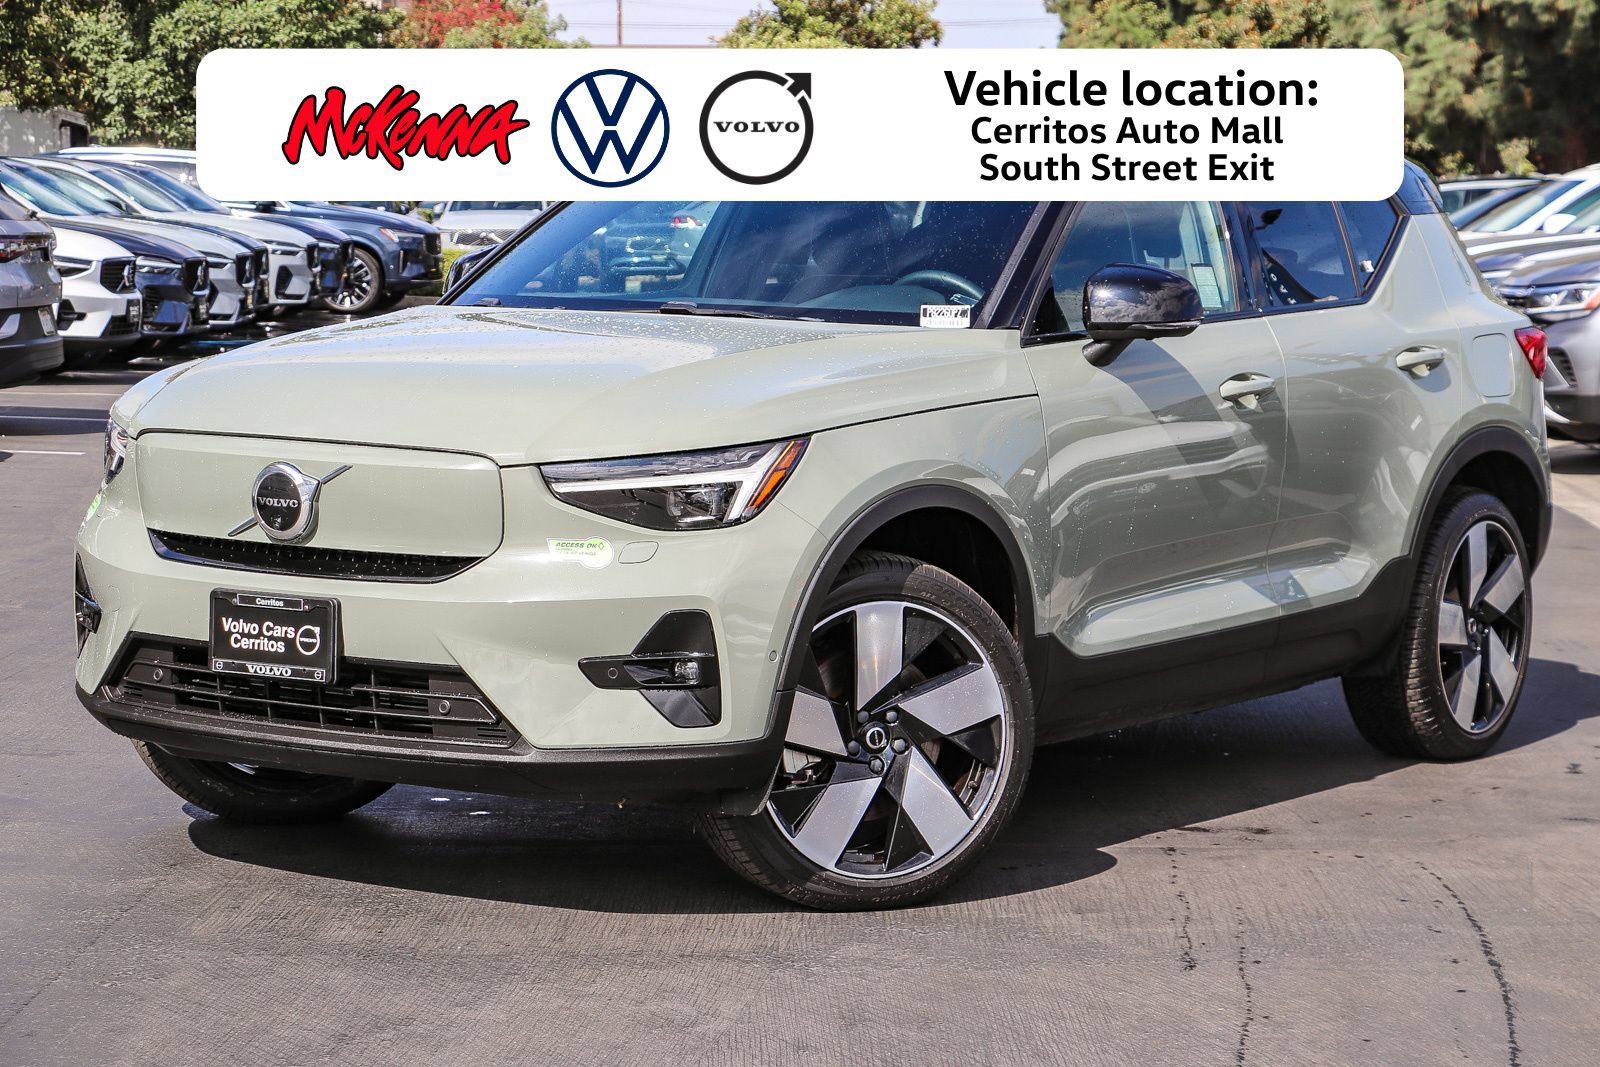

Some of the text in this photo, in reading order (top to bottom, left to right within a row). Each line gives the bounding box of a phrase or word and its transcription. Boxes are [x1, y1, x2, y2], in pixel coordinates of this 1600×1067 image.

[257, 496, 299, 508] VOLVO
[256, 597, 284, 607] Cerritos
[222, 617, 296, 639] Volvo Cars
[230, 634, 285, 653] Cerritos
[246, 663, 292, 677] VOLVO
